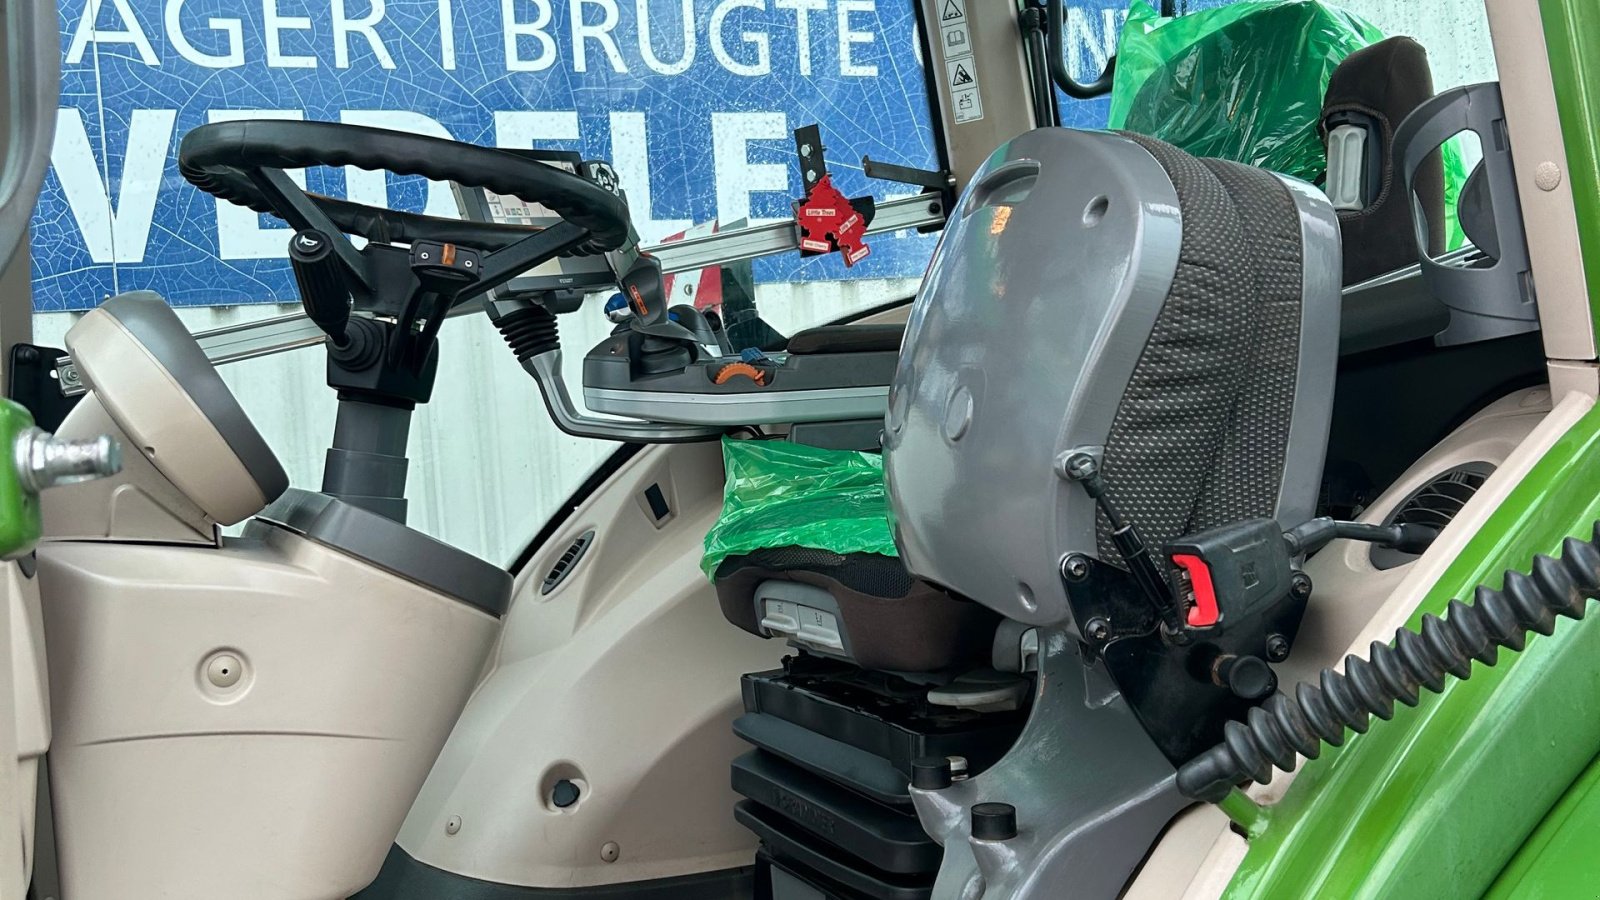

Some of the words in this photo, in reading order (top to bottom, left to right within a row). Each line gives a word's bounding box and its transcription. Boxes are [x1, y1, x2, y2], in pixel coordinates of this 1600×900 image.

[65, 0, 397, 69] AGER
[502, 0, 878, 76] BRUGTE
[51, 108, 796, 263] VEDLE
